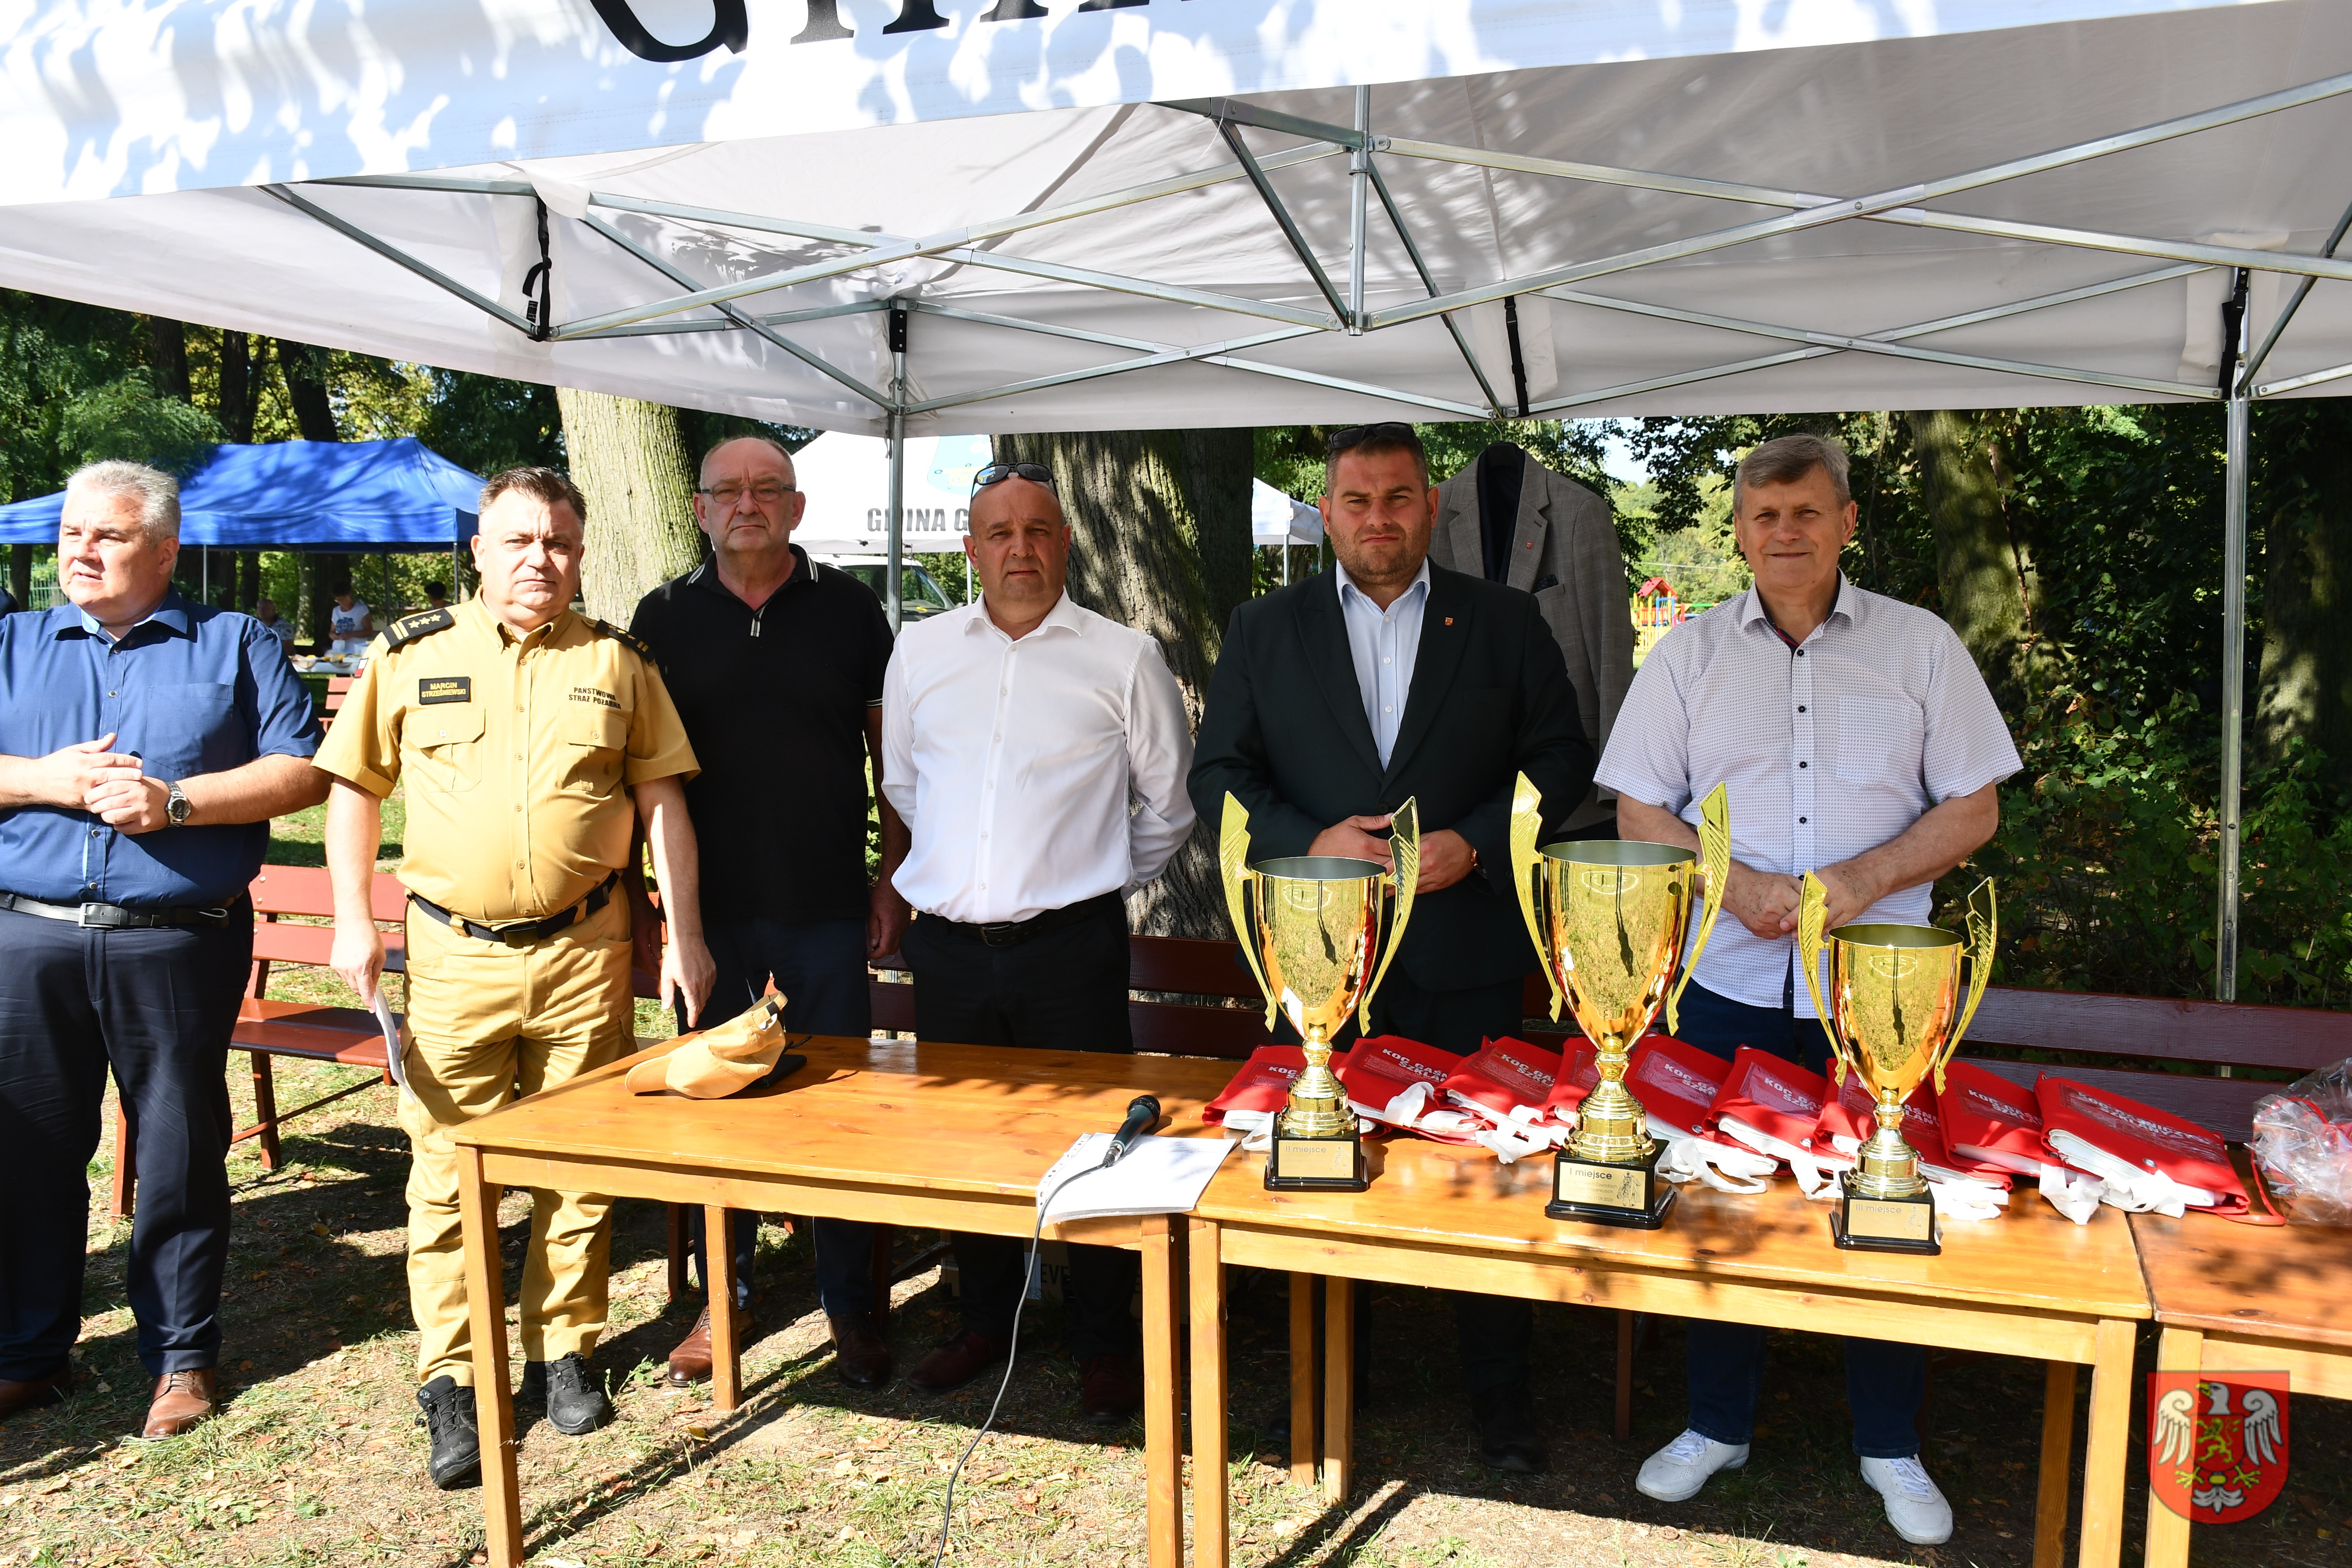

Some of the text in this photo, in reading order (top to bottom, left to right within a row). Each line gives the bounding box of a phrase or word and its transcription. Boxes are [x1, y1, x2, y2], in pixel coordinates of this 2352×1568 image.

[868, 508, 946, 531] GINA
[422, 689, 466, 697] STRZEŚNIEWSKI
[430, 682, 457, 690] MARCIN
[574, 686, 616, 701] PAŃSTWOWA
[1382, 1048, 1410, 1063] KOC
[1501, 1054, 1529, 1070] KOC
[1269, 1066, 1297, 1074] KOC
[1664, 1063, 1693, 1081] KOC
[1764, 1077, 1792, 1097] KOC
[1968, 1089, 1998, 1105] KOC
[1293, 1145, 1326, 1154] miejsce
[1575, 1169, 1612, 1180] miejsce
[1866, 1205, 1902, 1214] miejsce
